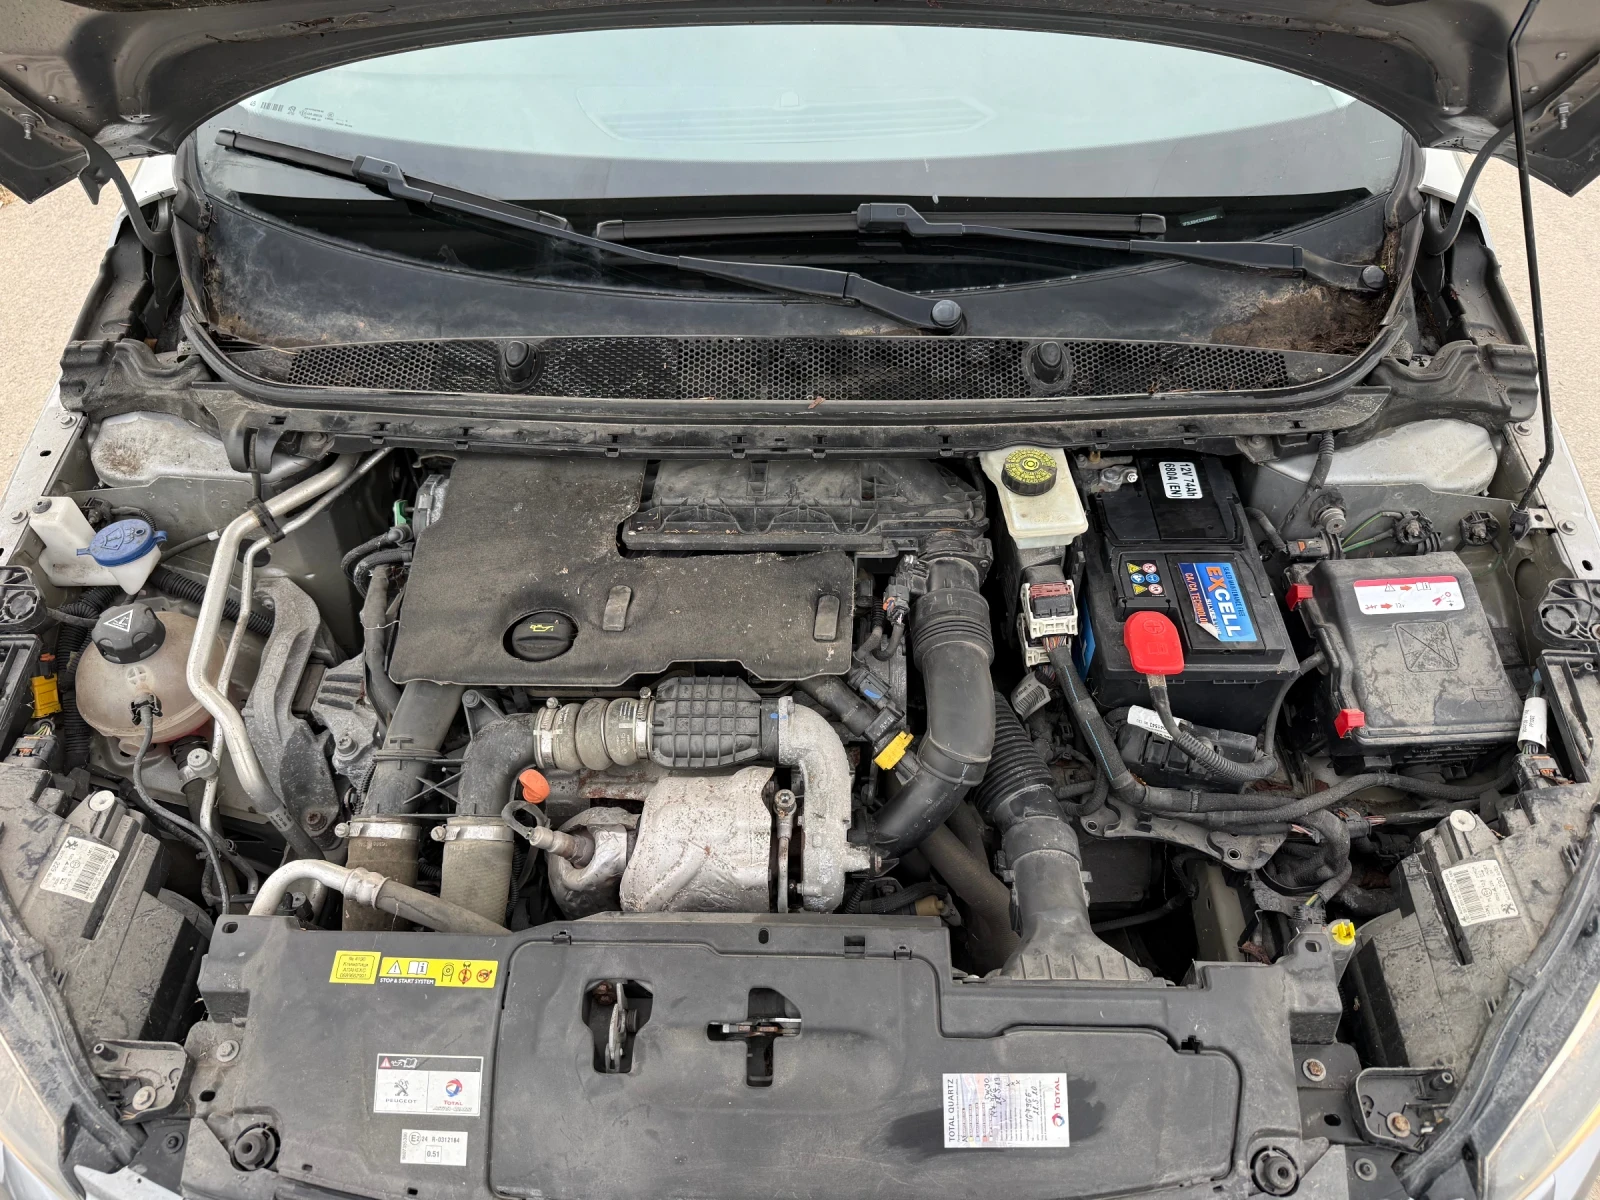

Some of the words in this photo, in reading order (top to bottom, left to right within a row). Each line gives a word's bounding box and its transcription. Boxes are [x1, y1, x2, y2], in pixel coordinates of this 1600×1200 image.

[1164, 463, 1178, 480] 680A
[1180, 464, 1193, 476] 12V
[1166, 483, 1182, 497] (EN)
[1184, 479, 1198, 496] 74Ah
[1185, 572, 1198, 592] CA/CA
[1206, 566, 1241, 636] EXCELL
[1206, 599, 1217, 619] SILVER
[1237, 607, 1245, 617] FREE
